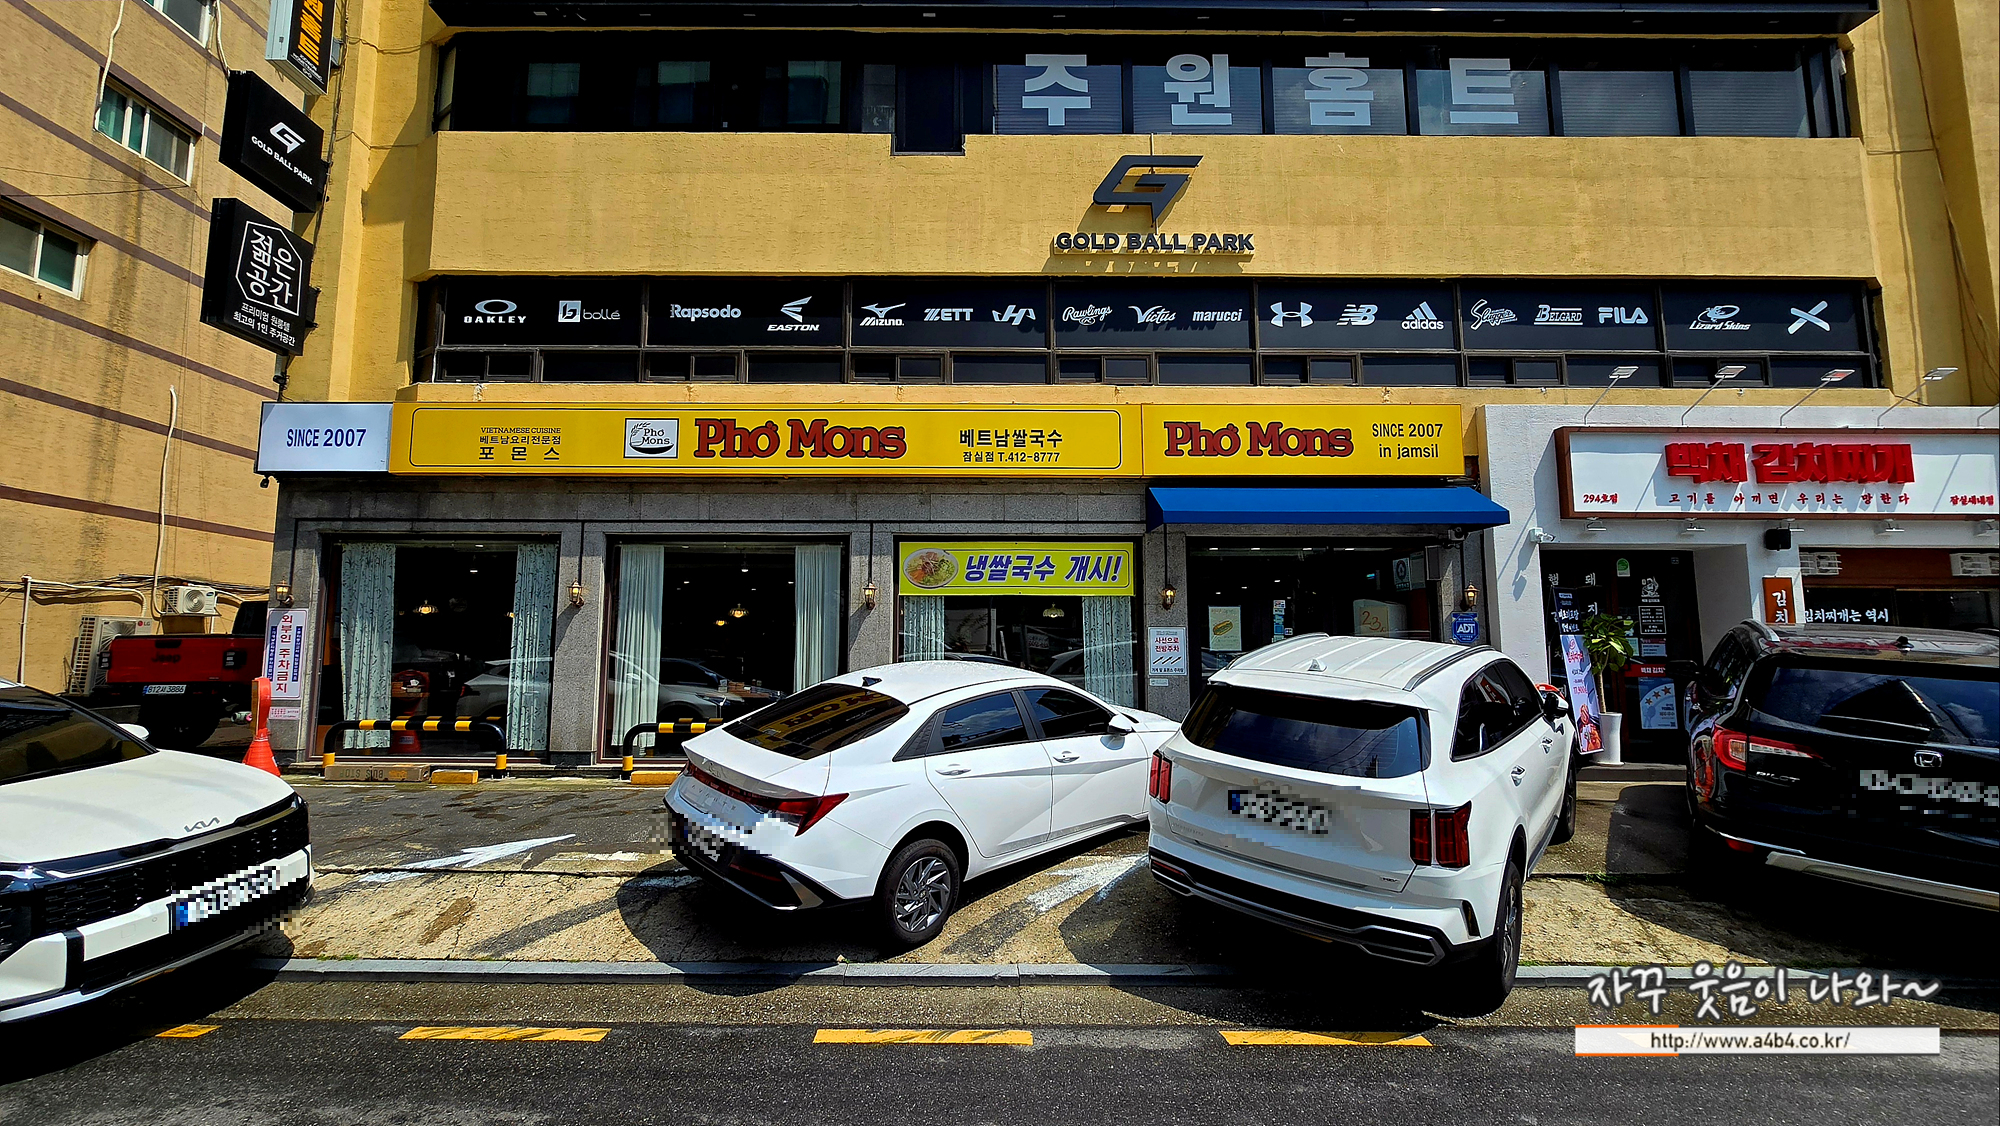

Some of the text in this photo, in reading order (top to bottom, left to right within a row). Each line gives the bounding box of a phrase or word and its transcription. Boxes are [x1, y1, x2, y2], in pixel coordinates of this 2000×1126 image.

[251, 135, 313, 185] GOLD BALL PARK
[1055, 233, 1254, 251] GOLD BALL PARK
[250, 228, 296, 280] 젊은
[246, 262, 293, 310] 공간
[241, 302, 269, 323] 프리미엄
[464, 316, 526, 324] OAKLEY
[583, 309, 621, 321] bollé
[670, 303, 741, 321] Rapsodo
[924, 308, 973, 321] ZETT
[1062, 304, 1113, 322] Rawlings
[1128, 305, 1176, 324] Victus
[1192, 308, 1242, 322] marucci
[1598, 307, 1648, 324] FILA
[233, 311, 296, 347] 최고의 1인 주거공간
[1402, 319, 1444, 330] adidas
[1689, 320, 1751, 330] Lizard Skins
[286, 428, 367, 448] SINCE 2007
[786, 418, 907, 459] Mons
[959, 429, 1063, 447] 베트남쌀국수
[1372, 424, 1443, 437] SINCE 2007
[480, 435, 561, 444] 베트남요리전문점
[642, 437, 670, 445] Mons
[1247, 421, 1354, 458] Mons
[479, 446, 560, 461] 포몬스
[962, 451, 1060, 463] 잠실점 T.412-8777
[1379, 443, 1439, 460] in jamsil
[1665, 442, 1915, 484] 백채 김치찌개
[1583, 493, 1618, 504] 294호점
[1669, 493, 1910, 505] 고기를 아끼면 우리는 망한다
[964, 555, 1123, 582] 냉쌀국수 개시!
[1804, 608, 1889, 623] 김치찌개는 역시
[280, 614, 293, 643] 외부인
[1456, 623, 1476, 634] ADT
[151, 653, 182, 664] Jeep
[275, 648, 291, 694] 주차금지
[1756, 770, 1800, 782] PILOT
